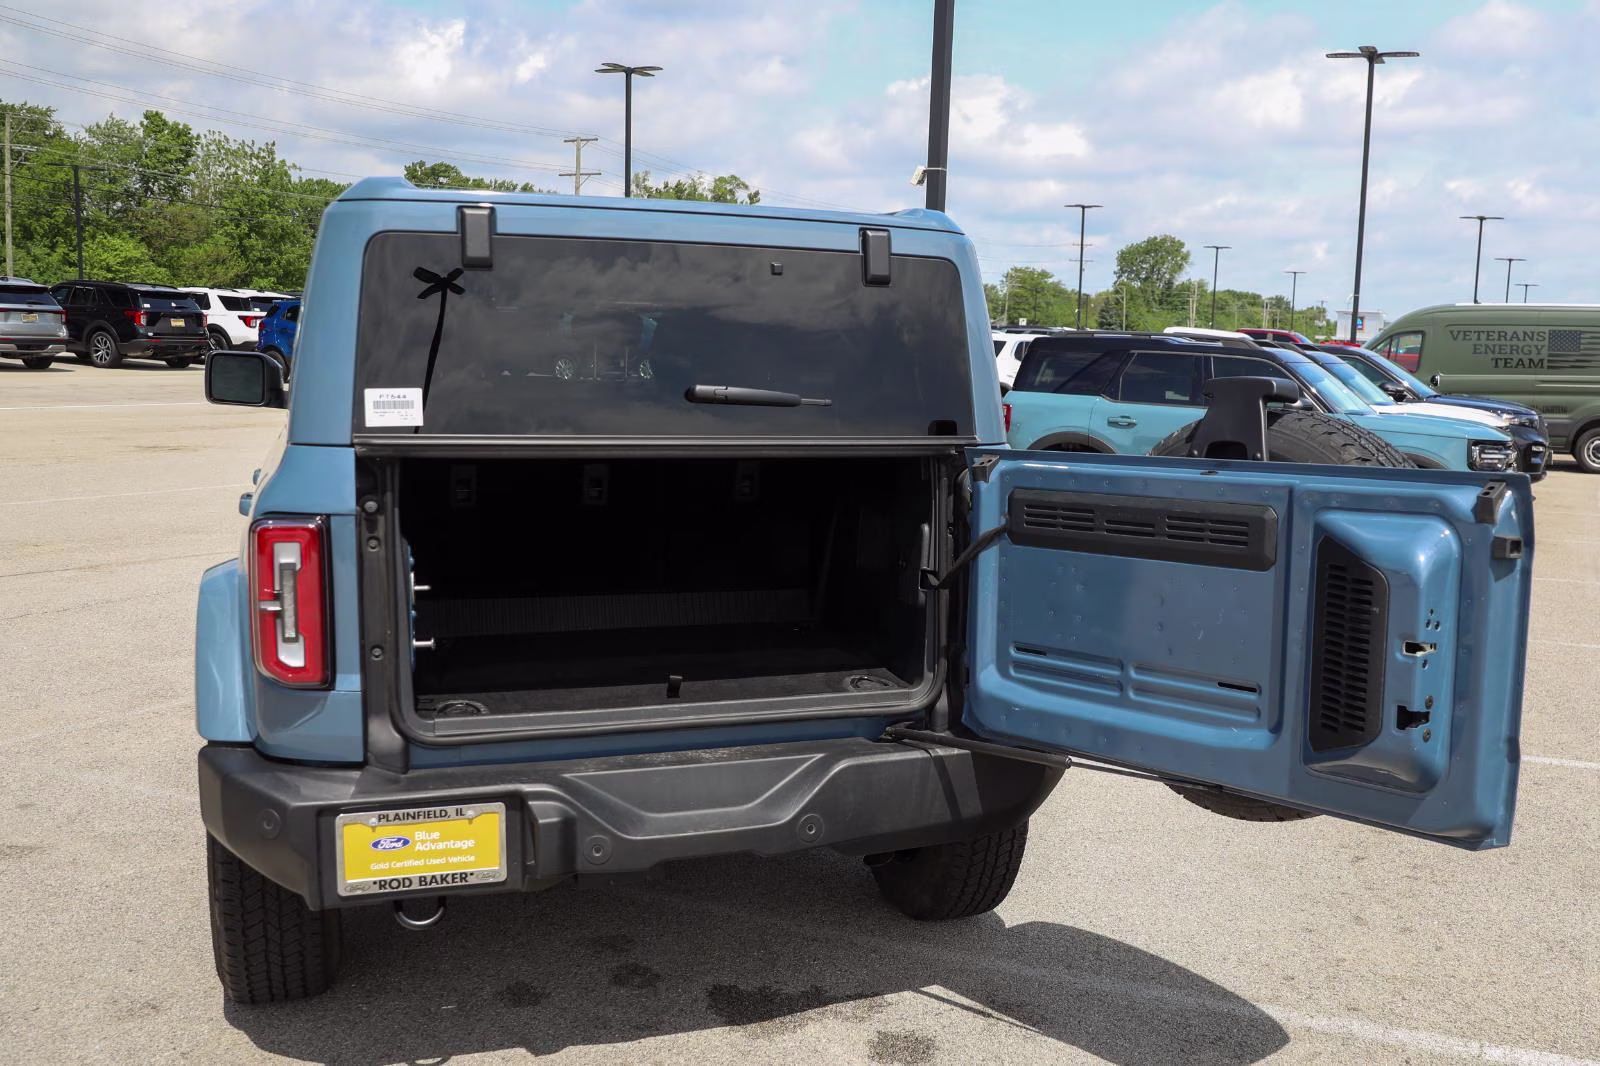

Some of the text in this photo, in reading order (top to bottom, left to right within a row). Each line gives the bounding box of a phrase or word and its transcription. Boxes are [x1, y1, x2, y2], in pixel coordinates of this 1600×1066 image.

[1449, 330, 1547, 342] VETERANS
[1472, 344, 1546, 356] ENERGY
[1491, 357, 1546, 369] TEAM
[378, 807, 466, 823] PLAINFIELD, IL
[414, 831, 441, 842] Blue
[375, 837, 405, 850] Ford
[415, 839, 475, 851] Advantage
[370, 854, 475, 870] Gold Certified Used Vehicle
